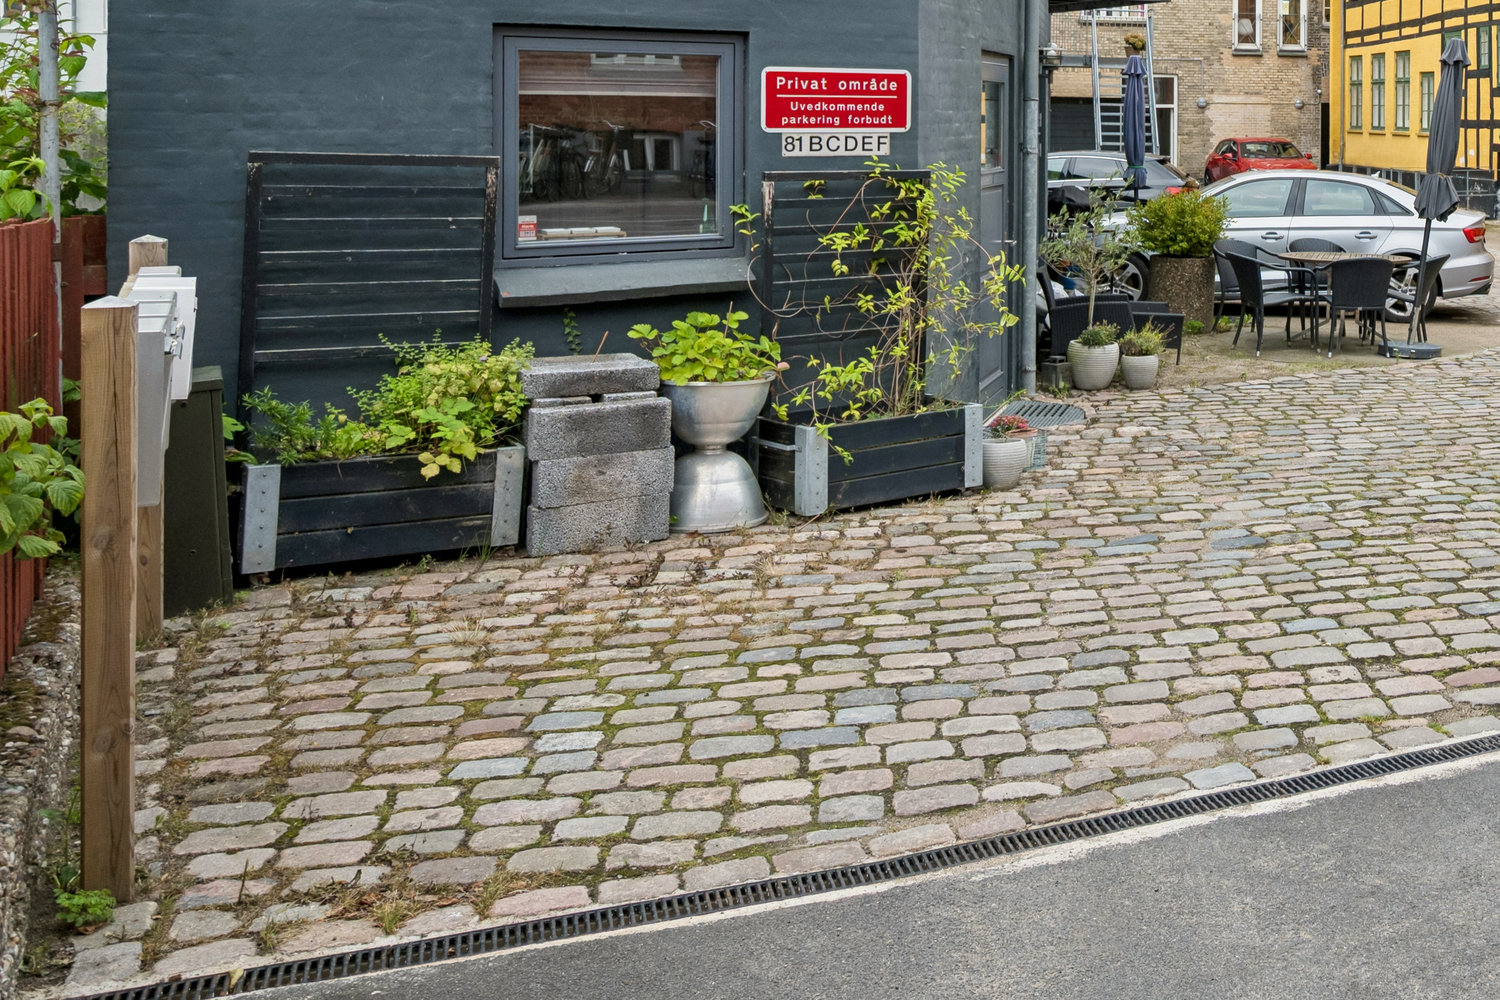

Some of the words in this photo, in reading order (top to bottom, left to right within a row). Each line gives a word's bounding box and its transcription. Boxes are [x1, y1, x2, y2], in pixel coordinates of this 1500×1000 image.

[776, 76, 828, 90] Privat
[838, 78, 898, 91] område
[790, 101, 885, 112] Uvedkommende
[781, 115, 840, 126] parkering
[848, 114, 893, 125] forbudt
